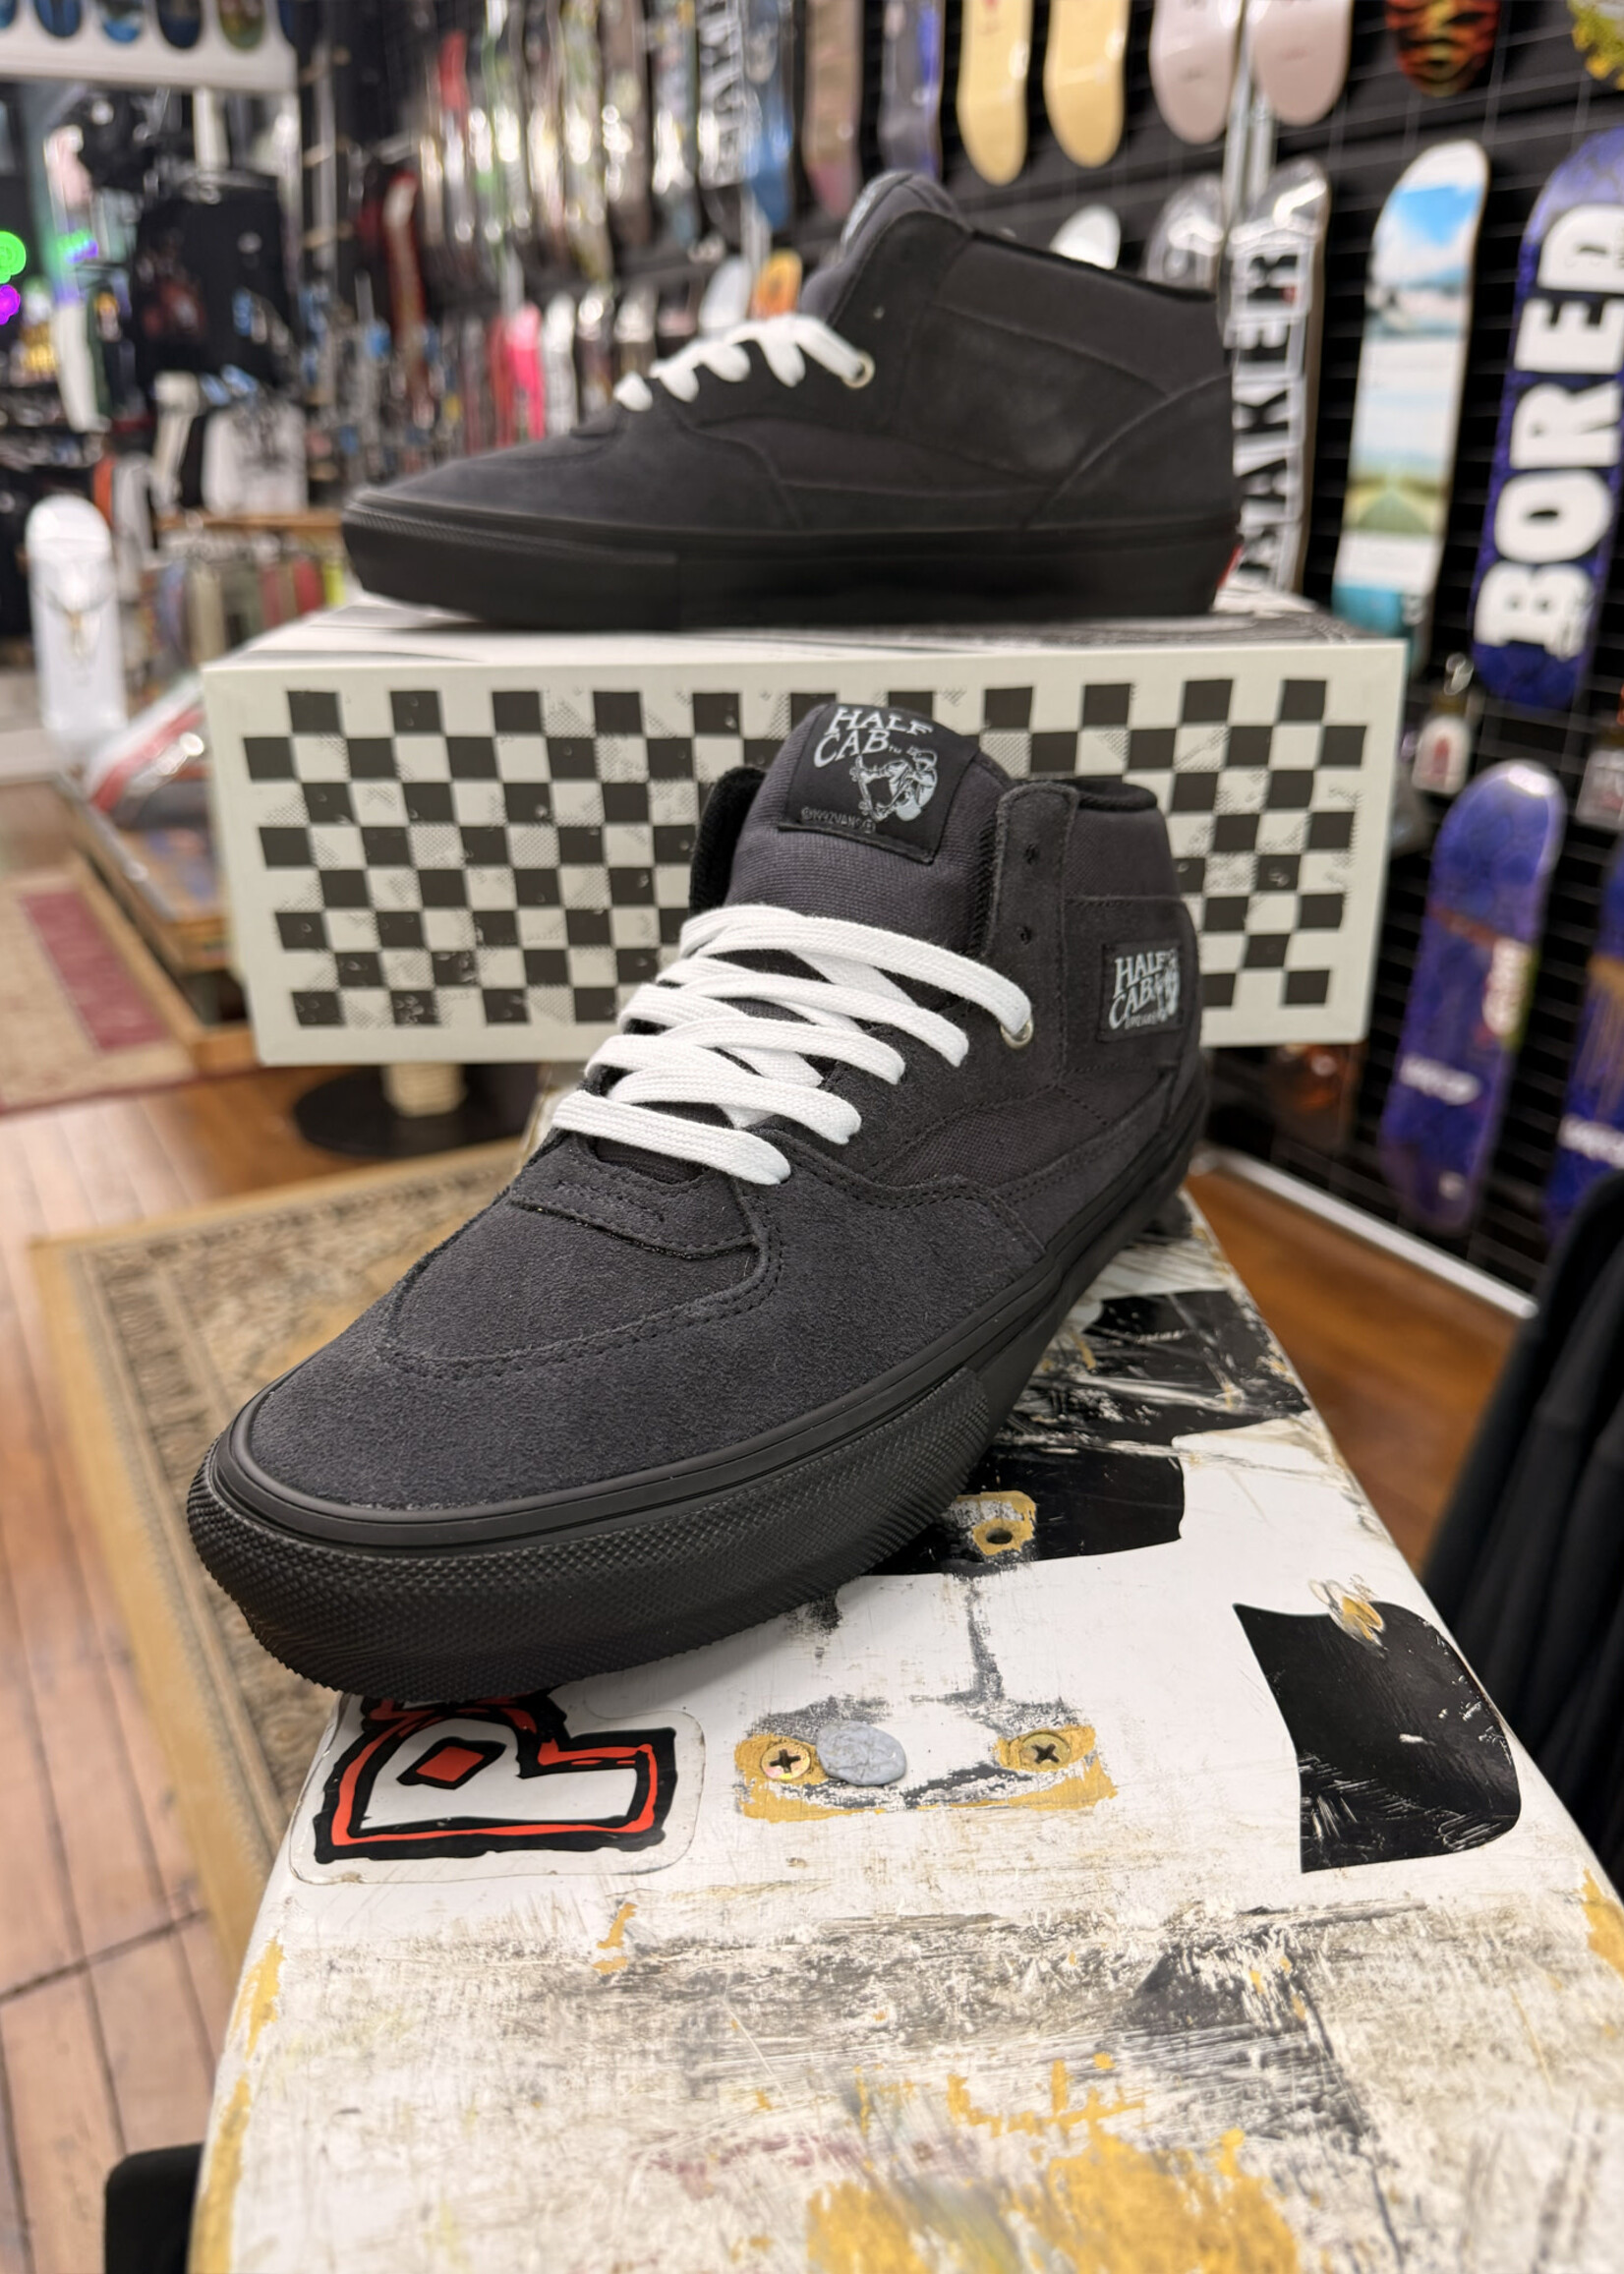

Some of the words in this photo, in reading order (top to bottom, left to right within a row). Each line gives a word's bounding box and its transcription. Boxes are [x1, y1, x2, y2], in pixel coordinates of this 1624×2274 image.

[1474, 204, 1624, 659] BORED
[824, 706, 934, 736] HALF
[814, 729, 891, 769] CAB
[1113, 950, 1168, 1000] HALF
[1108, 975, 1154, 1030] CAB
